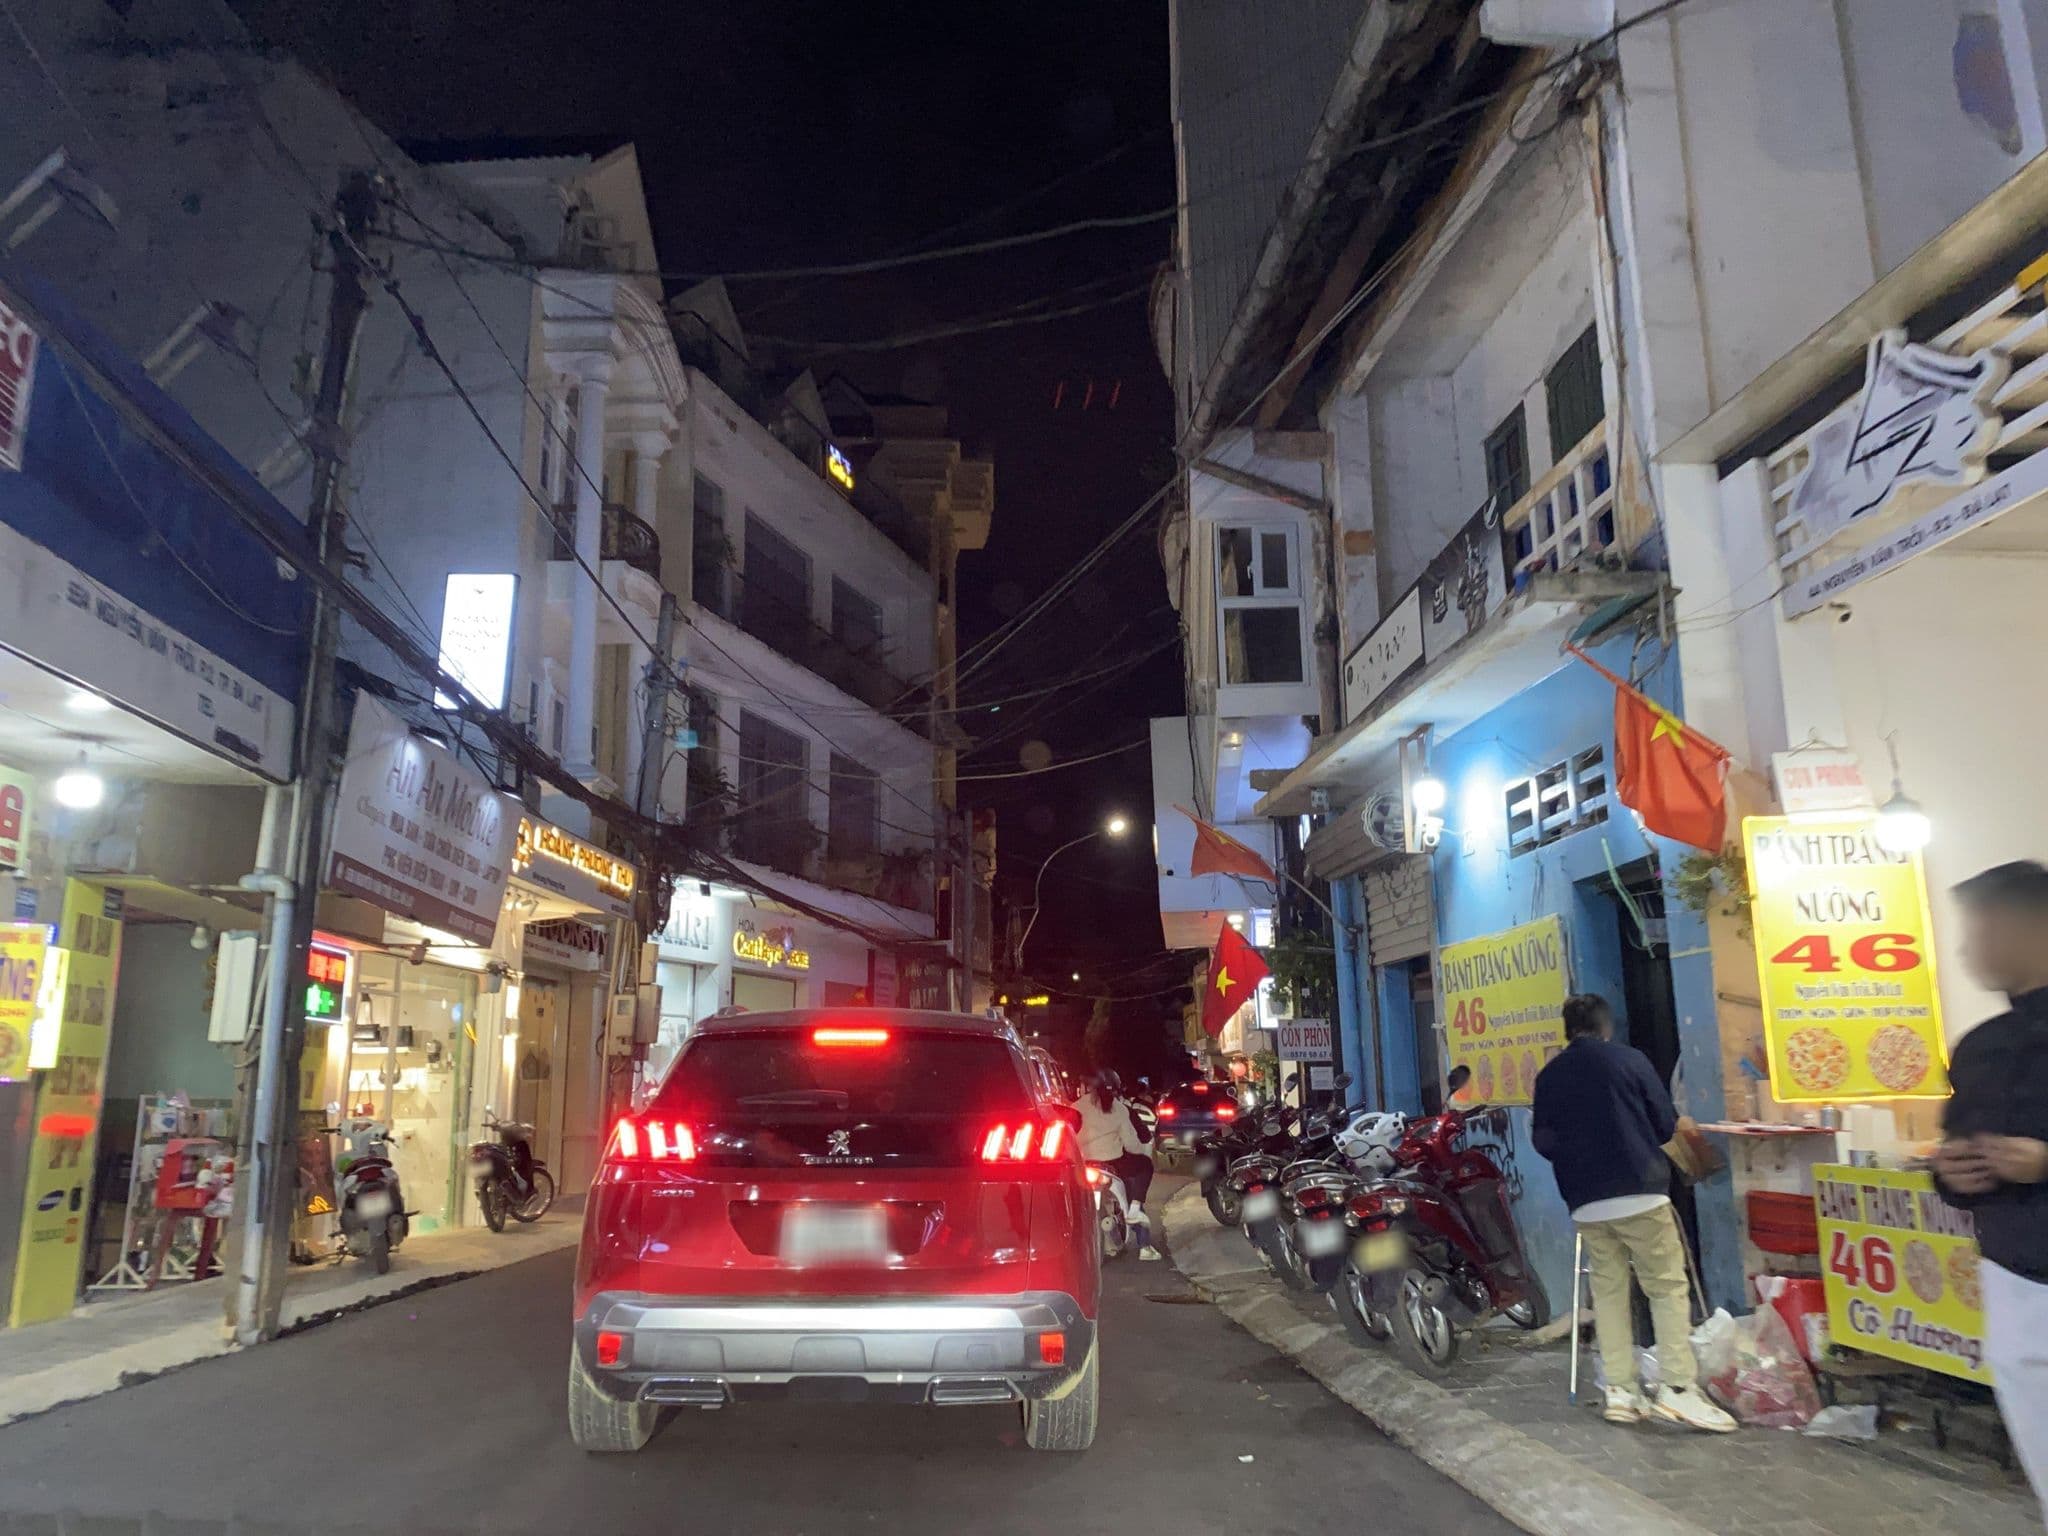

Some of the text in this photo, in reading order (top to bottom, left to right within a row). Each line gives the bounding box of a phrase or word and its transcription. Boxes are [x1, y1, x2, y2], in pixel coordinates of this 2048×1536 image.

[1827, 828, 1909, 865] TRÁN
[1444, 954, 1474, 995] BÁNH
[1473, 944, 1511, 988] TRÁNG
[1771, 933, 1921, 973] 46
[1454, 997, 1486, 1038] 46
[1830, 1231, 1898, 1294] 46
[1847, 1298, 1984, 1371] Cô Hương
